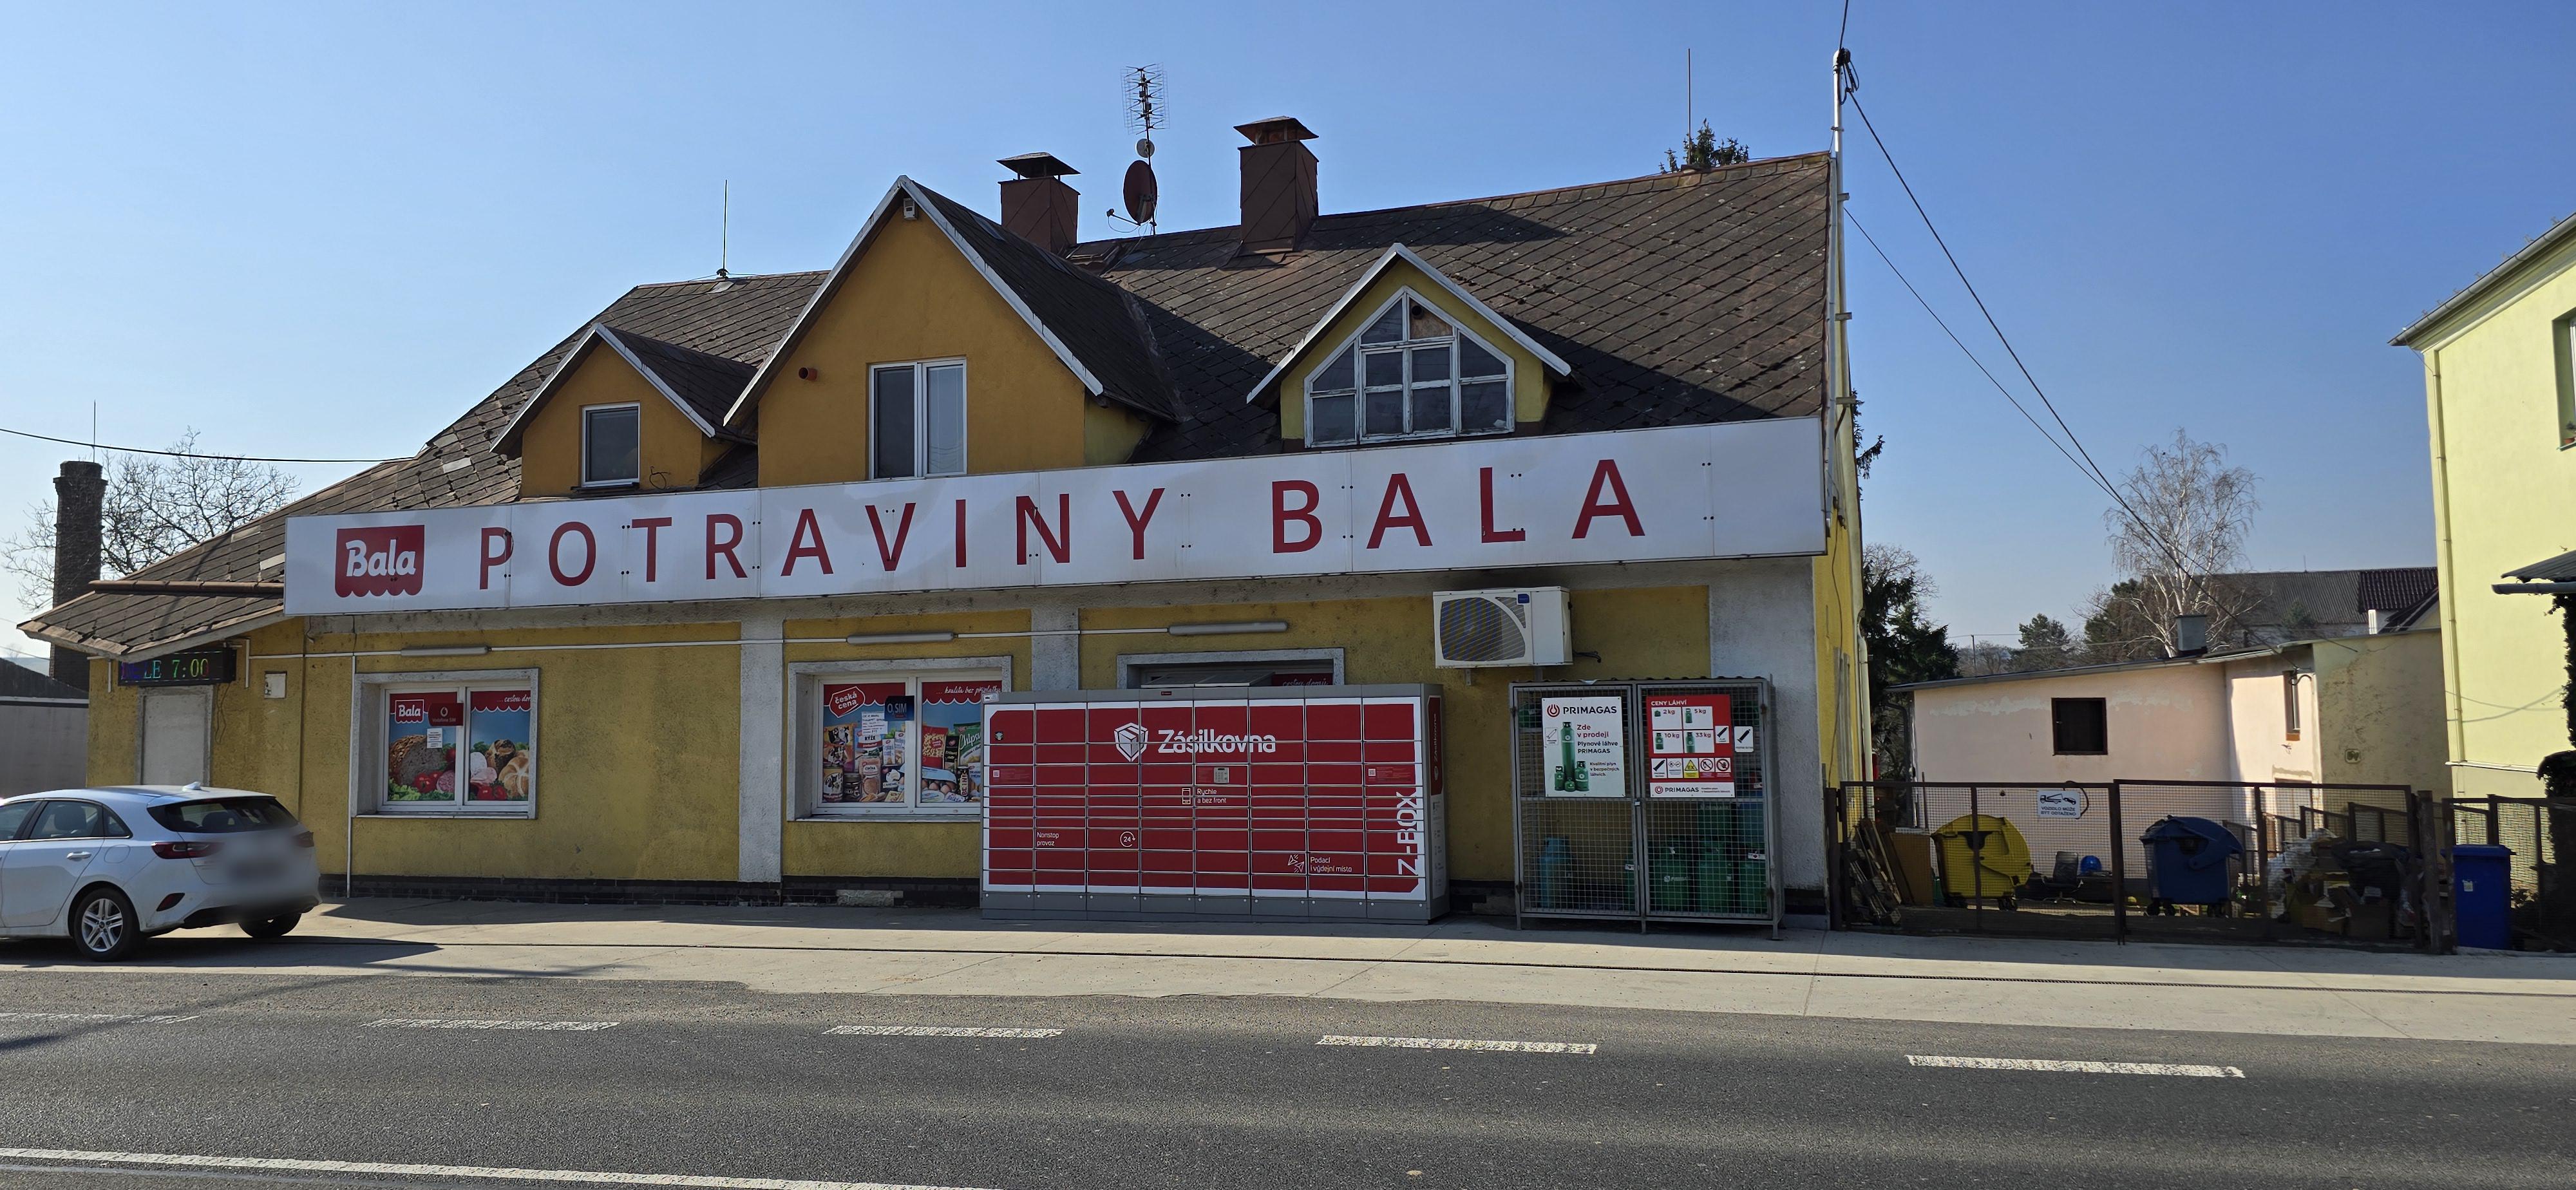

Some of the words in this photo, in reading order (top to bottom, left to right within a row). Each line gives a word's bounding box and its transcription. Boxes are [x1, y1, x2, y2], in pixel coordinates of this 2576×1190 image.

[479, 487, 1165, 590] POTRAVINY
[1272, 458, 1646, 554] BALA
[345, 538, 416, 577] Bala
[171, 658, 209, 678] 7:00
[835, 691, 858, 704] česká
[838, 699, 858, 710] cena
[398, 704, 421, 717] Bala
[895, 703, 907, 713] SIM
[1563, 706, 1617, 714] PRIMAGAS
[1157, 728, 1276, 753] Zásilkovna
[1396, 791, 1419, 876] Z-BOX
